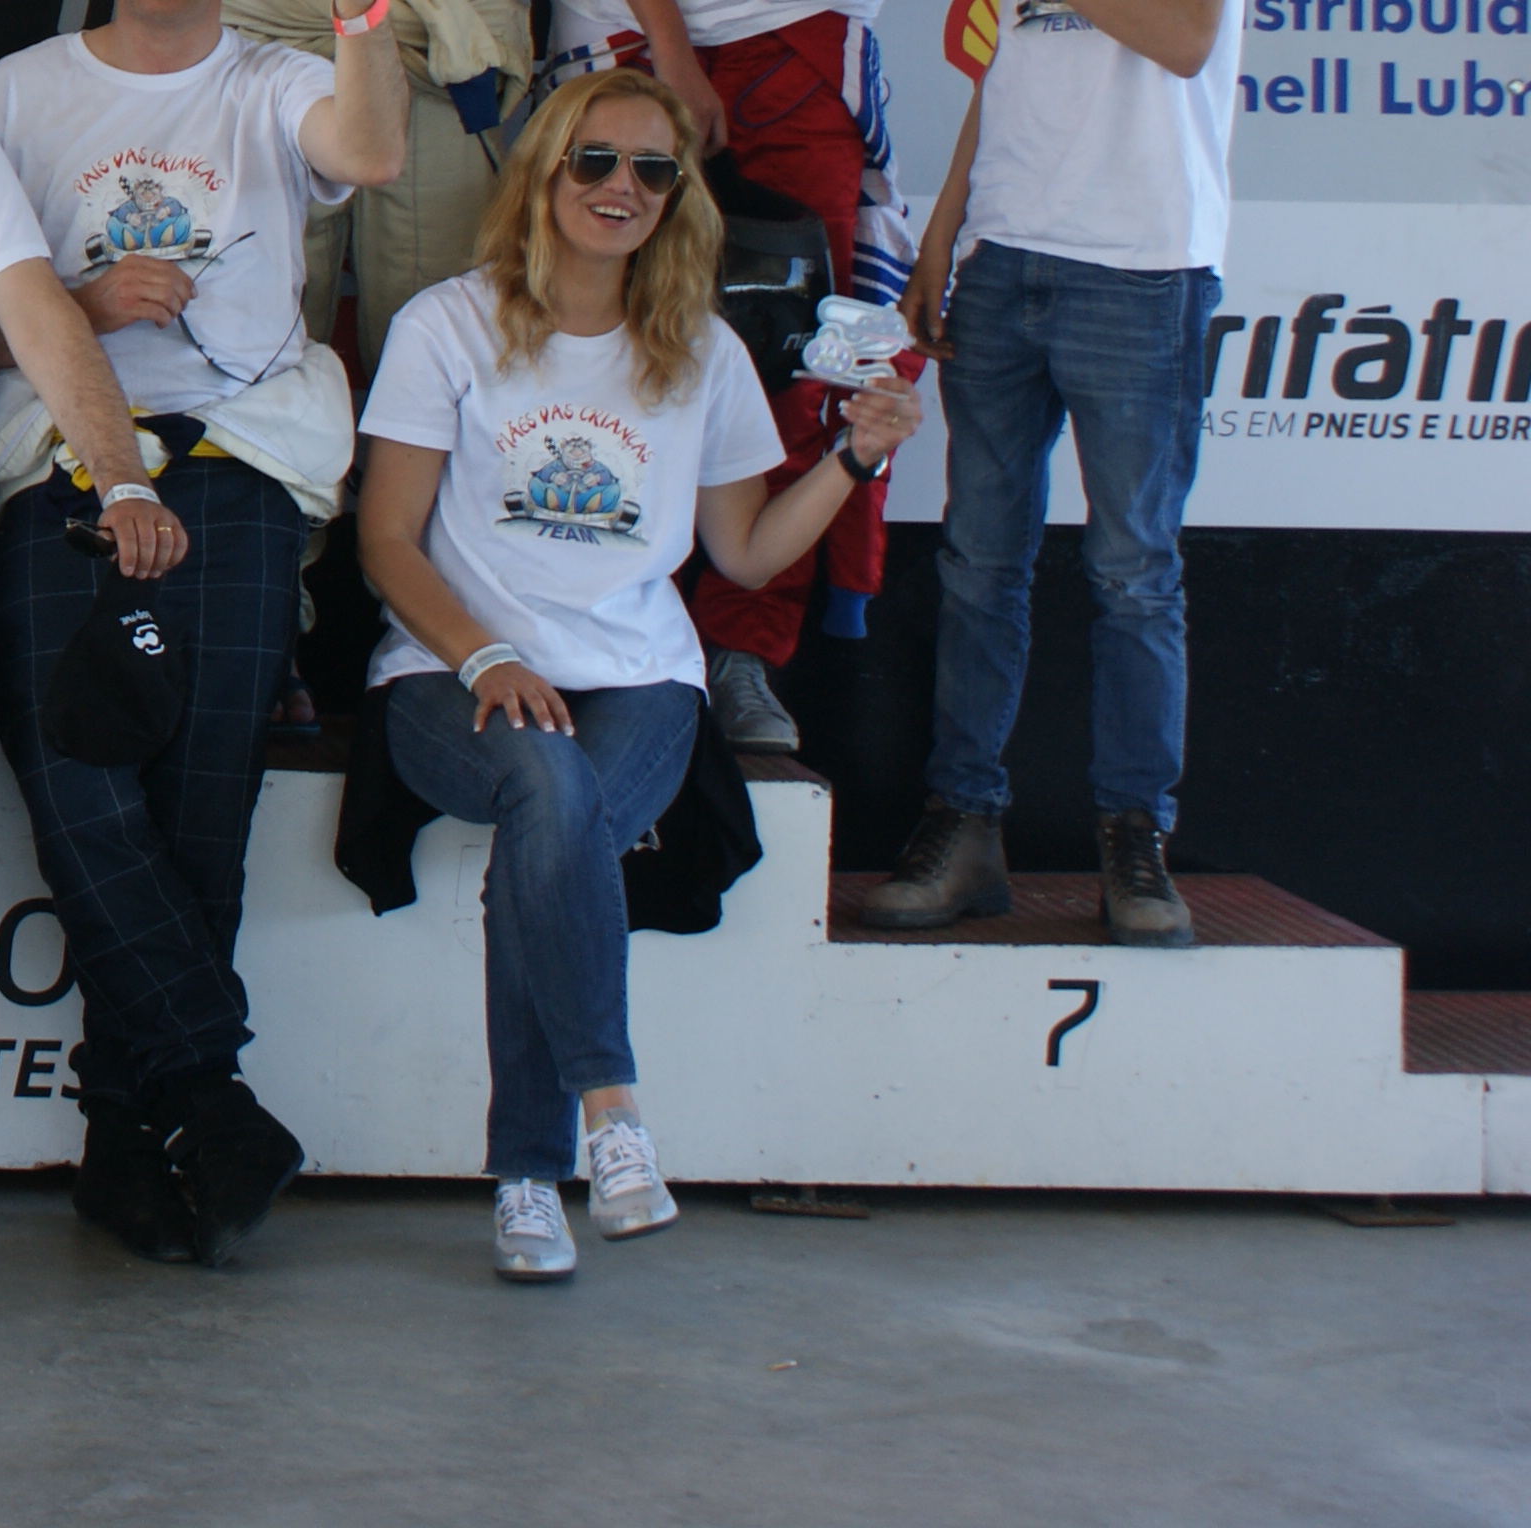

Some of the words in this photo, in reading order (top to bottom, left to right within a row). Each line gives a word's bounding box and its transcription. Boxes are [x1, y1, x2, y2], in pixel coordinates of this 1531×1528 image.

[73, 159, 110, 194] PAIS
[112, 146, 148, 169] DAS
[539, 403, 574, 424] DAS
[1246, 410, 1296, 437] EM
[1302, 412, 1411, 439] PNEUS
[1418, 414, 1442, 440] E
[537, 523, 602, 546] TEAM
[1044, 979, 1102, 1070] 7
